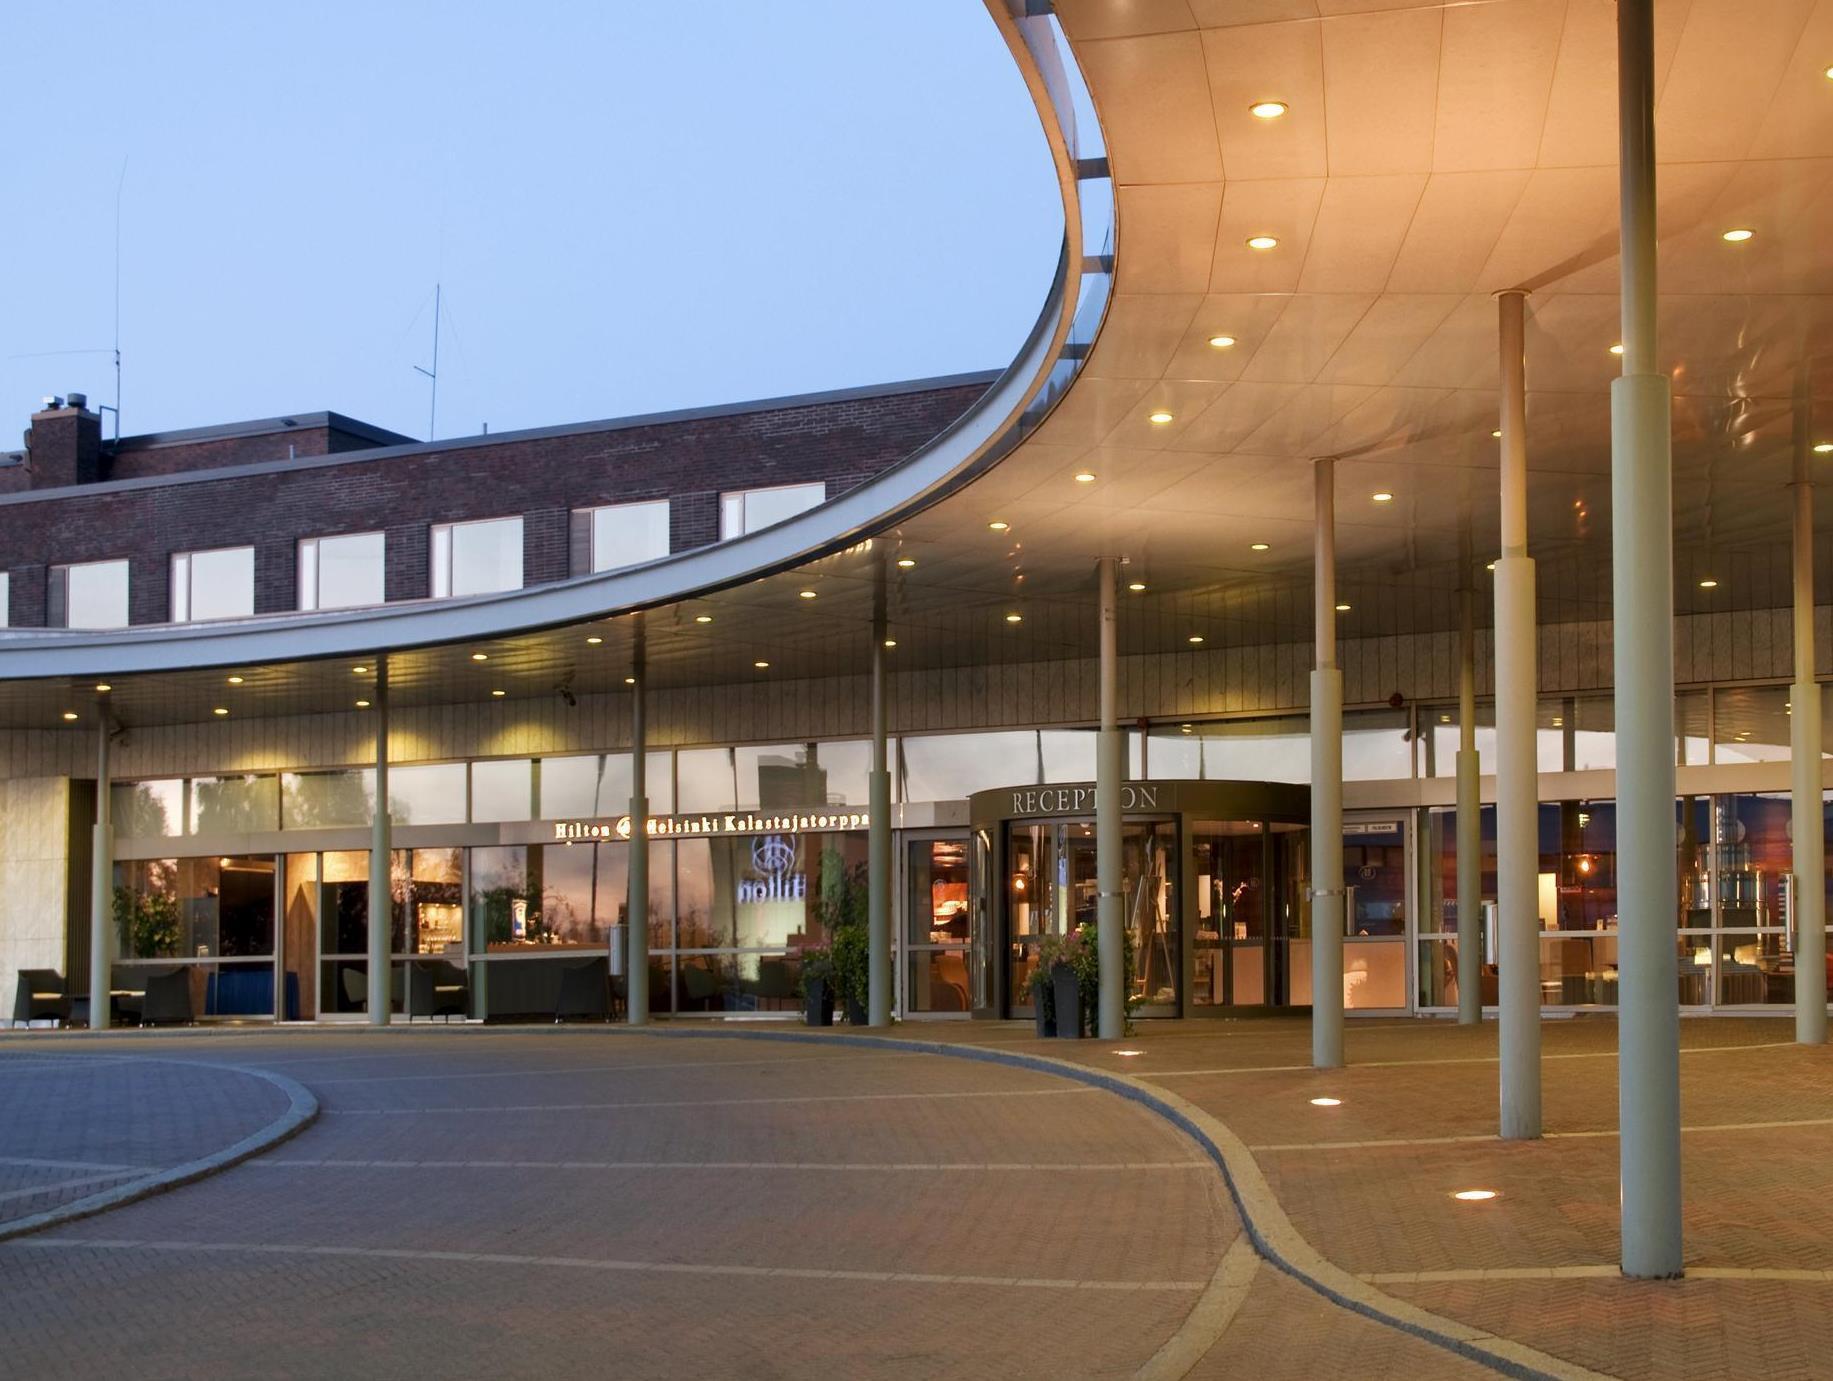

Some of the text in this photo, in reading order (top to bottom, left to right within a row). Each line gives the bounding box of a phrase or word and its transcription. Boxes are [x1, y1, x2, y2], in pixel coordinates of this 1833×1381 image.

[1012, 786, 1159, 814] RECEPTON
[555, 814, 870, 839] Hilton Helsinki Kalastajatorppa
